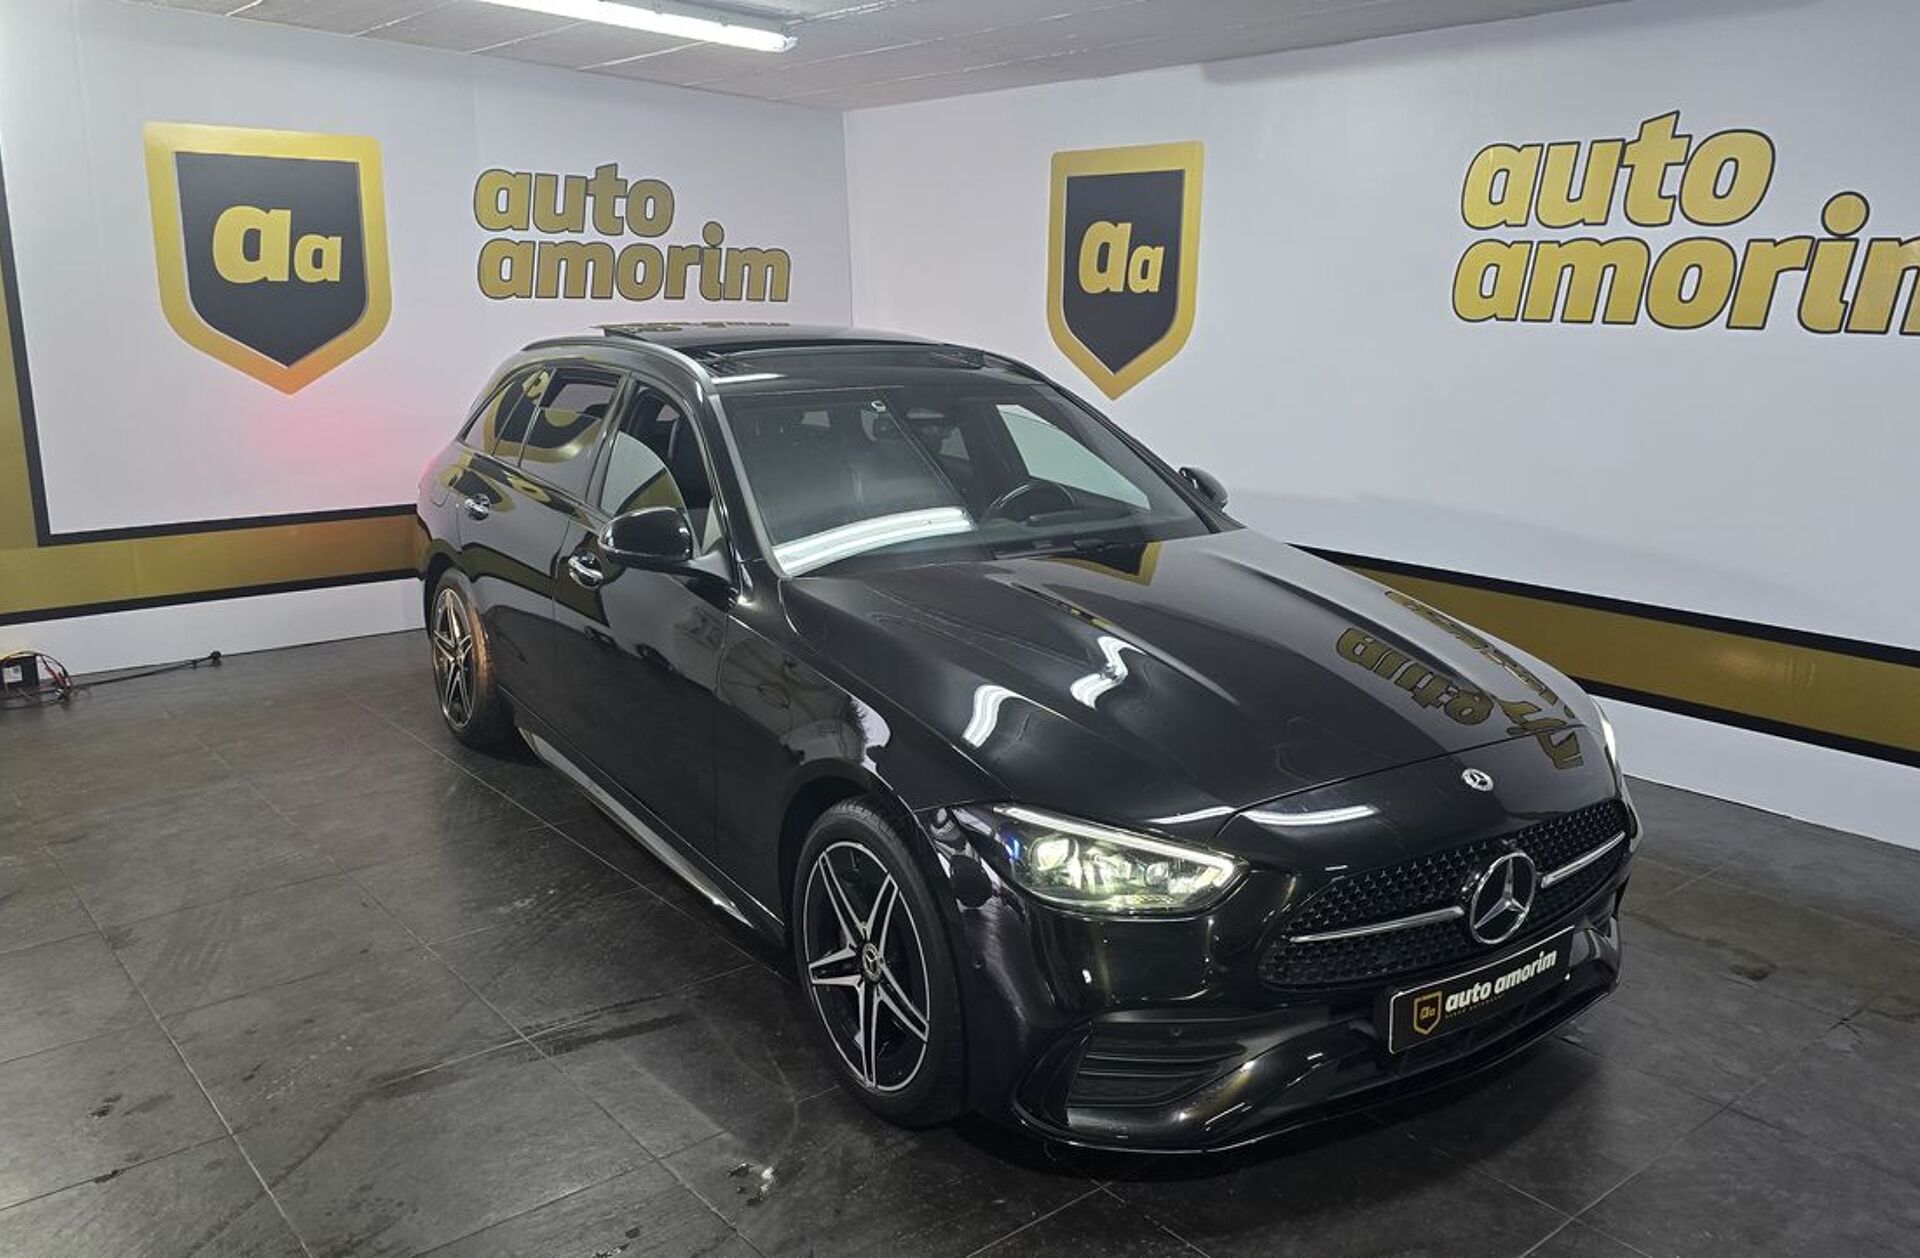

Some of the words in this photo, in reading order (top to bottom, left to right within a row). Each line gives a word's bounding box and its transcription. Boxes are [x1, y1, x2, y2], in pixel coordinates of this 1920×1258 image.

[473, 163, 675, 237] auto
[1460, 111, 1775, 229] auto
[477, 221, 791, 302] amorim
[1444, 981, 1492, 1013] auto
[1494, 950, 1558, 994] amorim
